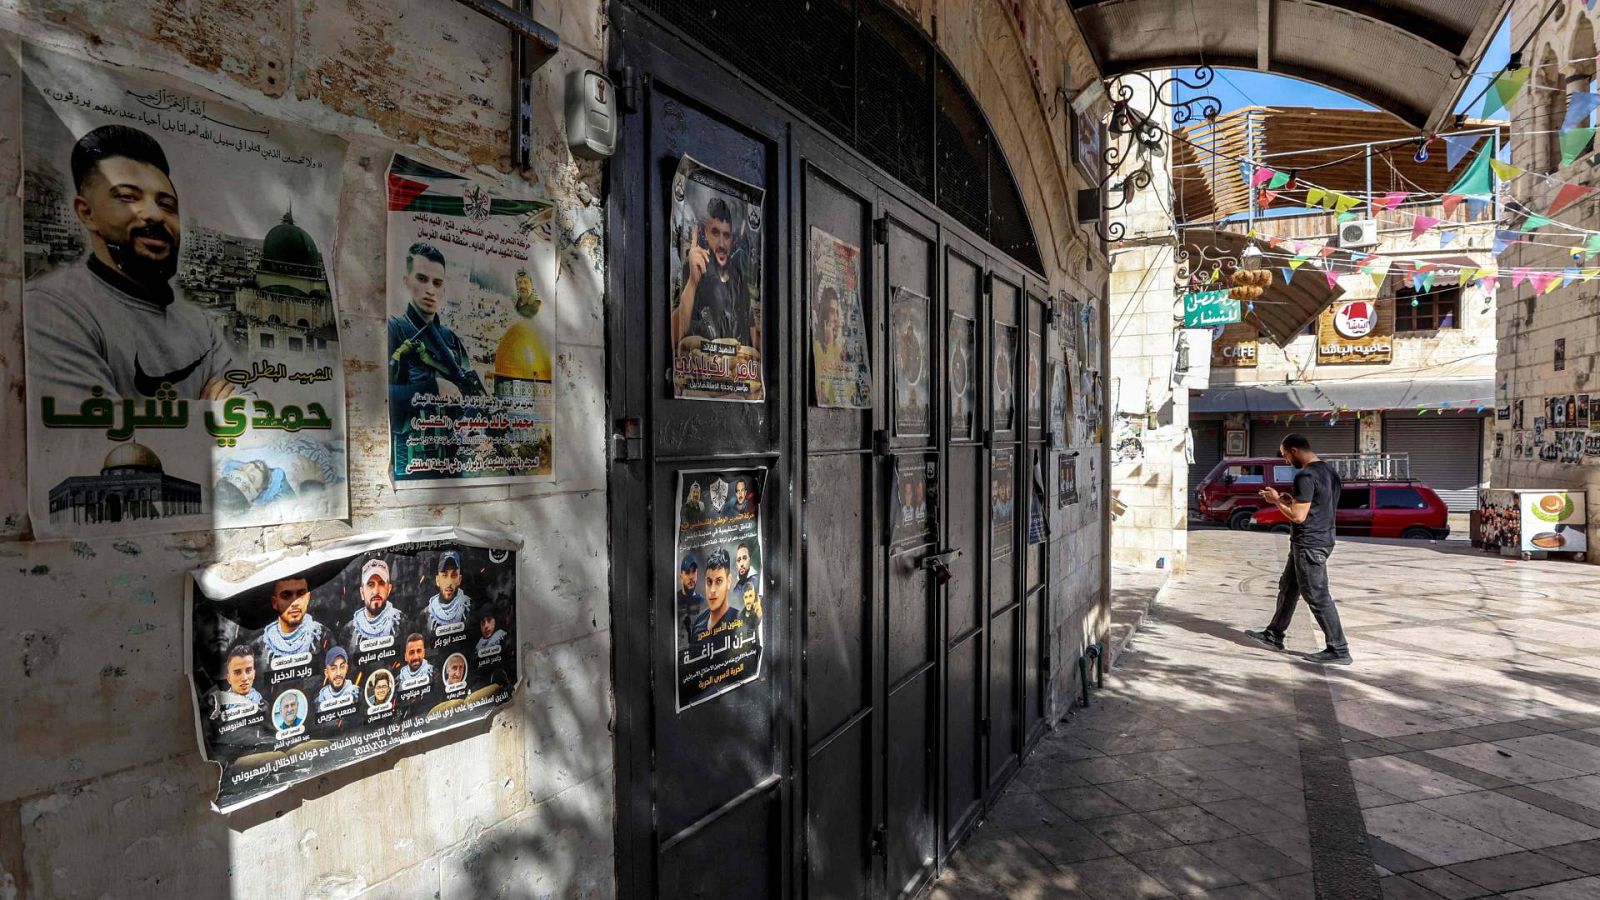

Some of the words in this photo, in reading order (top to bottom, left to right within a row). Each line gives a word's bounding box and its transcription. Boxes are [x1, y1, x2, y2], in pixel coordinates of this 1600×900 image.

[1190, 309, 1238, 327] للنساء
[1223, 346, 1255, 358] CAFE
[1321, 344, 1353, 356] الباشا
[224, 359, 286, 389] البطل
[289, 366, 333, 386] الشهيد
[734, 359, 758, 382] تامر
[41, 381, 189, 441] شرف
[203, 396, 332, 447] حمدي
[512, 416, 534, 428] محمد
[732, 631, 756, 650] يزن
[358, 653, 376, 665] سليم
[377, 649, 396, 661] حسام
[271, 669, 295, 684] الدخيل
[296, 666, 312, 678] وليد
[494, 691, 508, 703] الذين
[317, 712, 336, 724] عويص
[337, 706, 357, 718] مصعب
[425, 709, 442, 724] نابلس
[247, 715, 264, 725] محمد
[413, 717, 425, 728] جبل
[299, 748, 318, 761] قوات
[318, 746, 329, 757] مع
[272, 753, 298, 771] الاحتلال
[231, 763, 272, 785] الصهيوني
